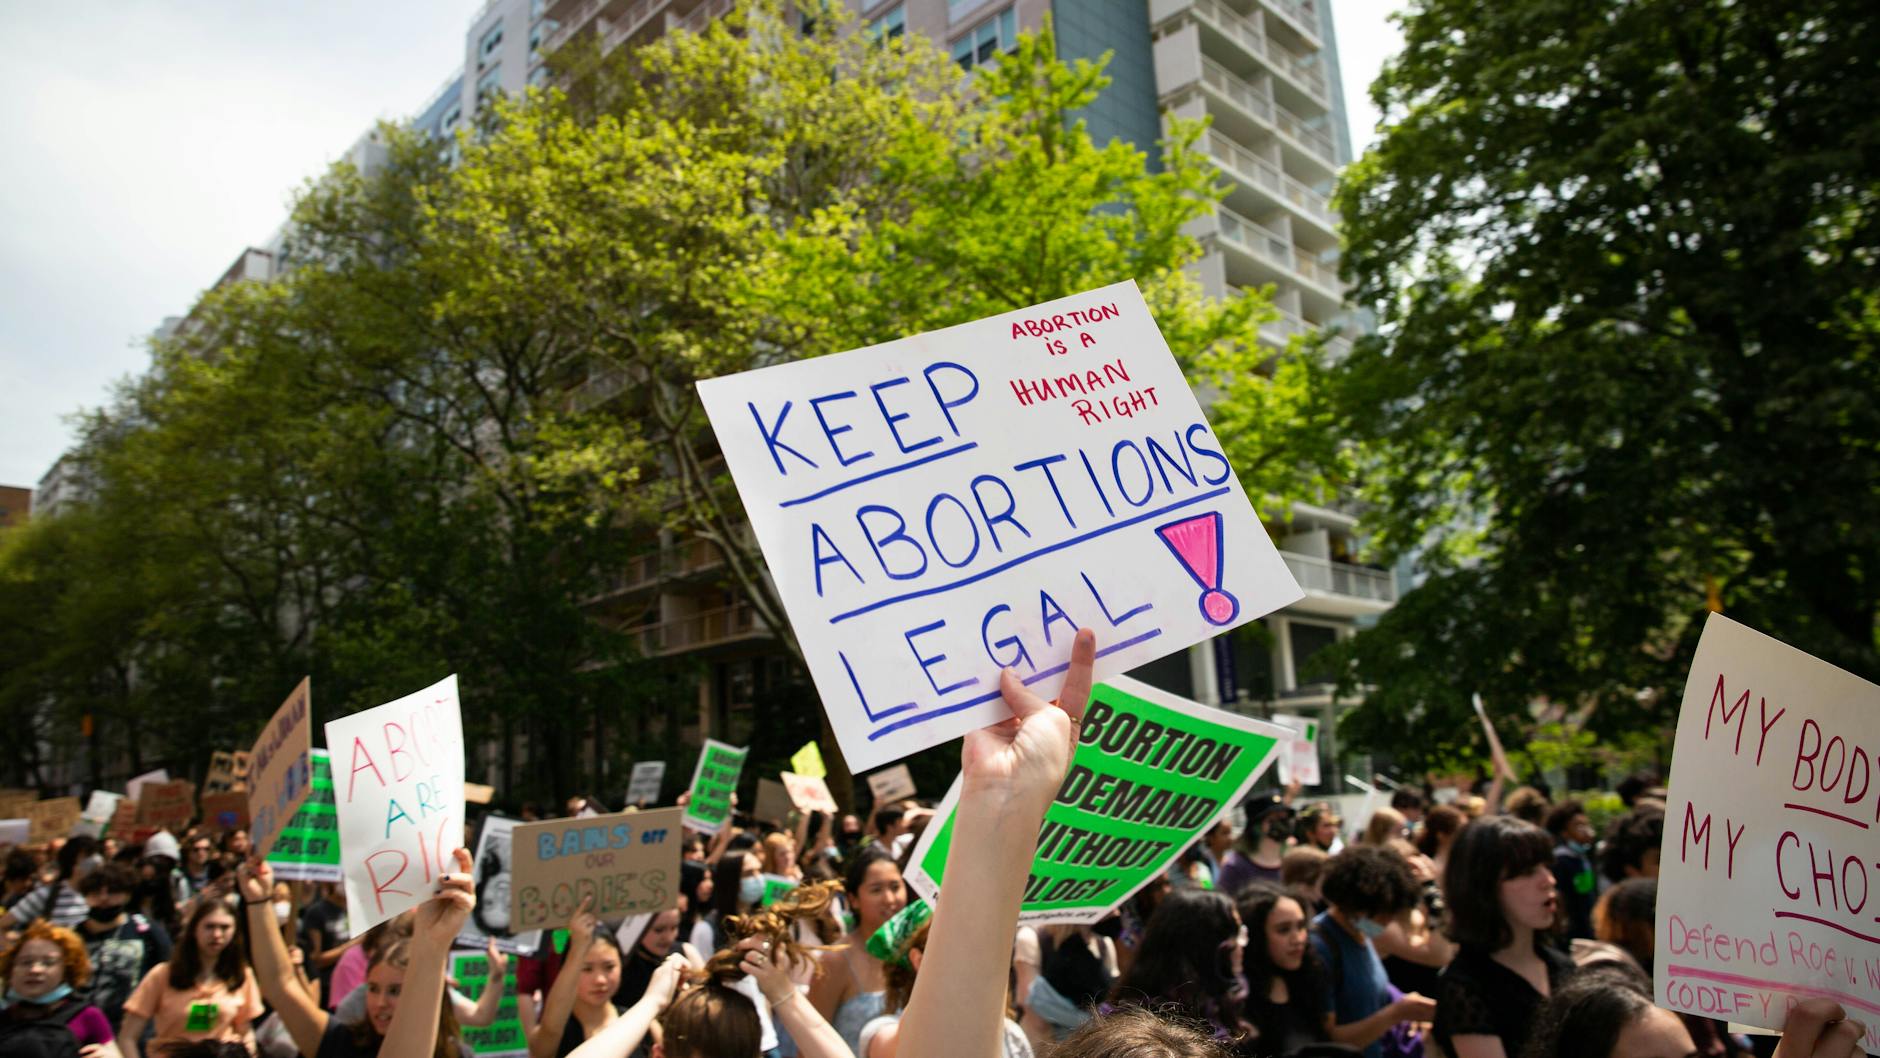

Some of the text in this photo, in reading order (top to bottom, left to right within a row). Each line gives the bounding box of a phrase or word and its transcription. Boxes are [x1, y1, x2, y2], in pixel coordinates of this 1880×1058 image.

[1011, 303, 1120, 339] ABORTION
[1079, 332, 1097, 348] A
[1009, 358, 1131, 406] HUMAN
[1071, 386, 1159, 426] RIGHT
[748, 361, 979, 475] KEEP
[811, 423, 1231, 597] ABORTIONS
[838, 571, 1153, 723] LEGAL
[1078, 699, 1245, 783] BORTION
[1705, 673, 1786, 768] MY
[385, 774, 447, 840] ARE
[1054, 763, 1220, 831] DEMAND
[538, 822, 633, 861] BANS
[584, 852, 616, 870] OUR
[1681, 800, 1880, 923] MY CHO
[518, 868, 668, 928] BODIES
[1668, 914, 1779, 967] Defend
[1787, 931, 1837, 978] Roe
[1665, 979, 1773, 1019] CODIFY
